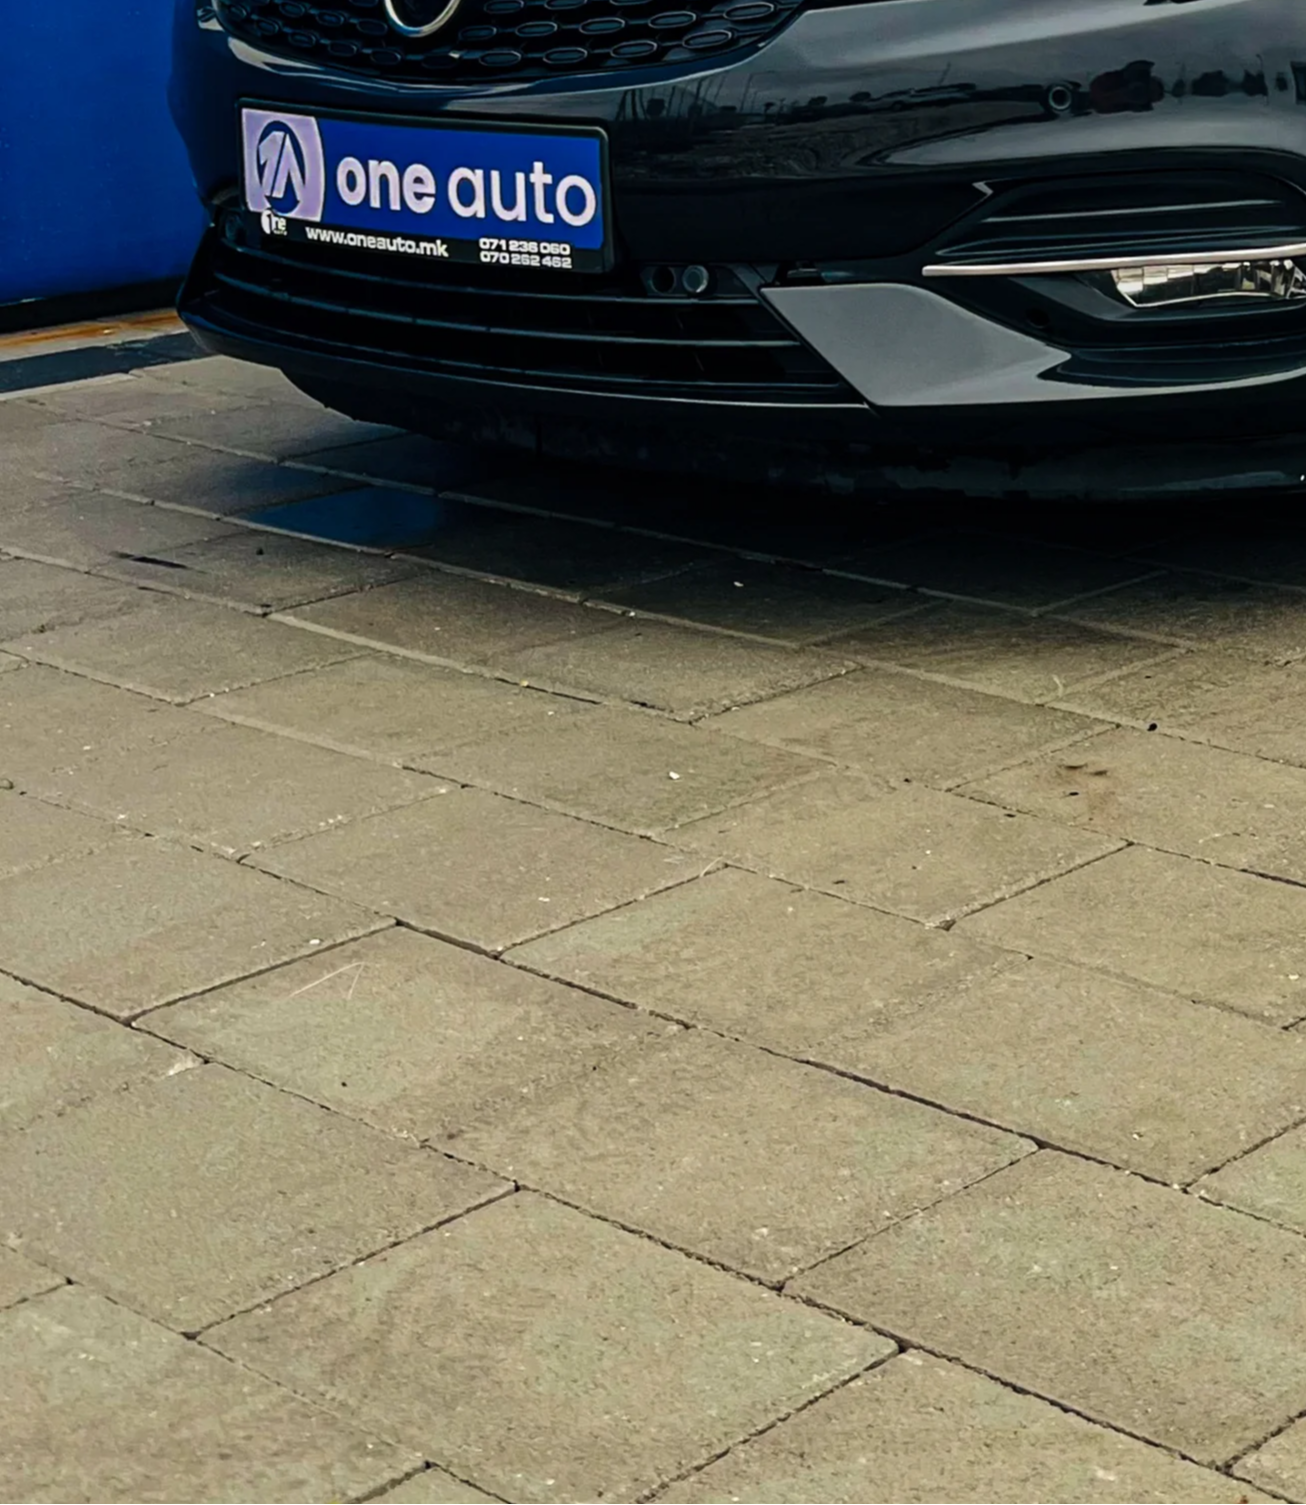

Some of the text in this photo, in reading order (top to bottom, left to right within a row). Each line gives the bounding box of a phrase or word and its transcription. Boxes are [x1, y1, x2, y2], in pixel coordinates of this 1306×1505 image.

[336, 156, 596, 226] one auto
[305, 226, 449, 258] www.oneauto.mk
[479, 237, 507, 251] 071
[480, 251, 510, 264] 070
